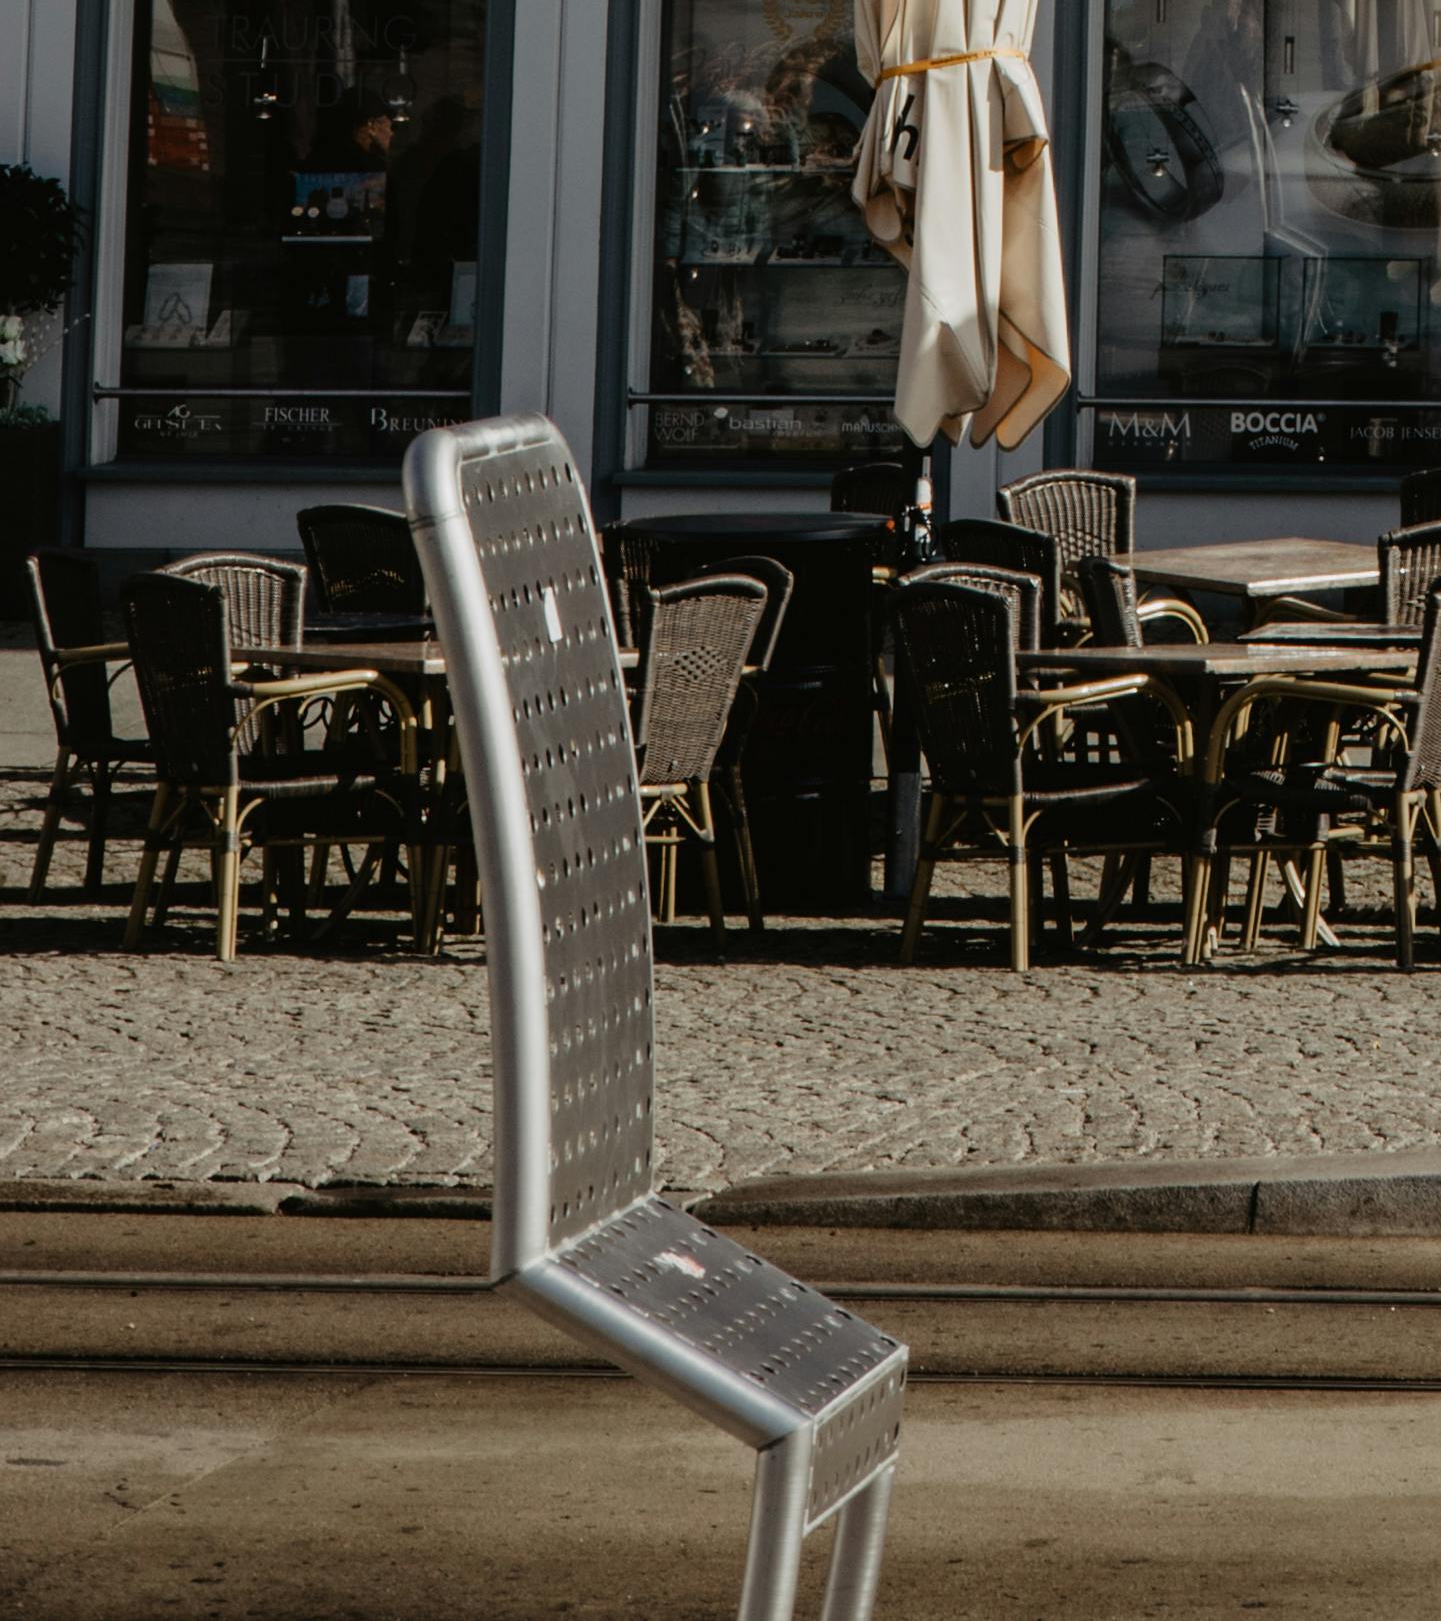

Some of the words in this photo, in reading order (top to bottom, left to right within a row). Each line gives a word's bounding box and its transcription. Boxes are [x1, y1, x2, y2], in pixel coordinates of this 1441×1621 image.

[265, 407, 330, 423] FISCHER
[655, 412, 704, 427] BERND
[728, 415, 802, 430] bastian
[1108, 412, 1192, 437] M&M
[1350, 425, 1394, 439] JACOB
[655, 428, 700, 441] WOLF
[1249, 436, 1300, 452] TITANIUM
